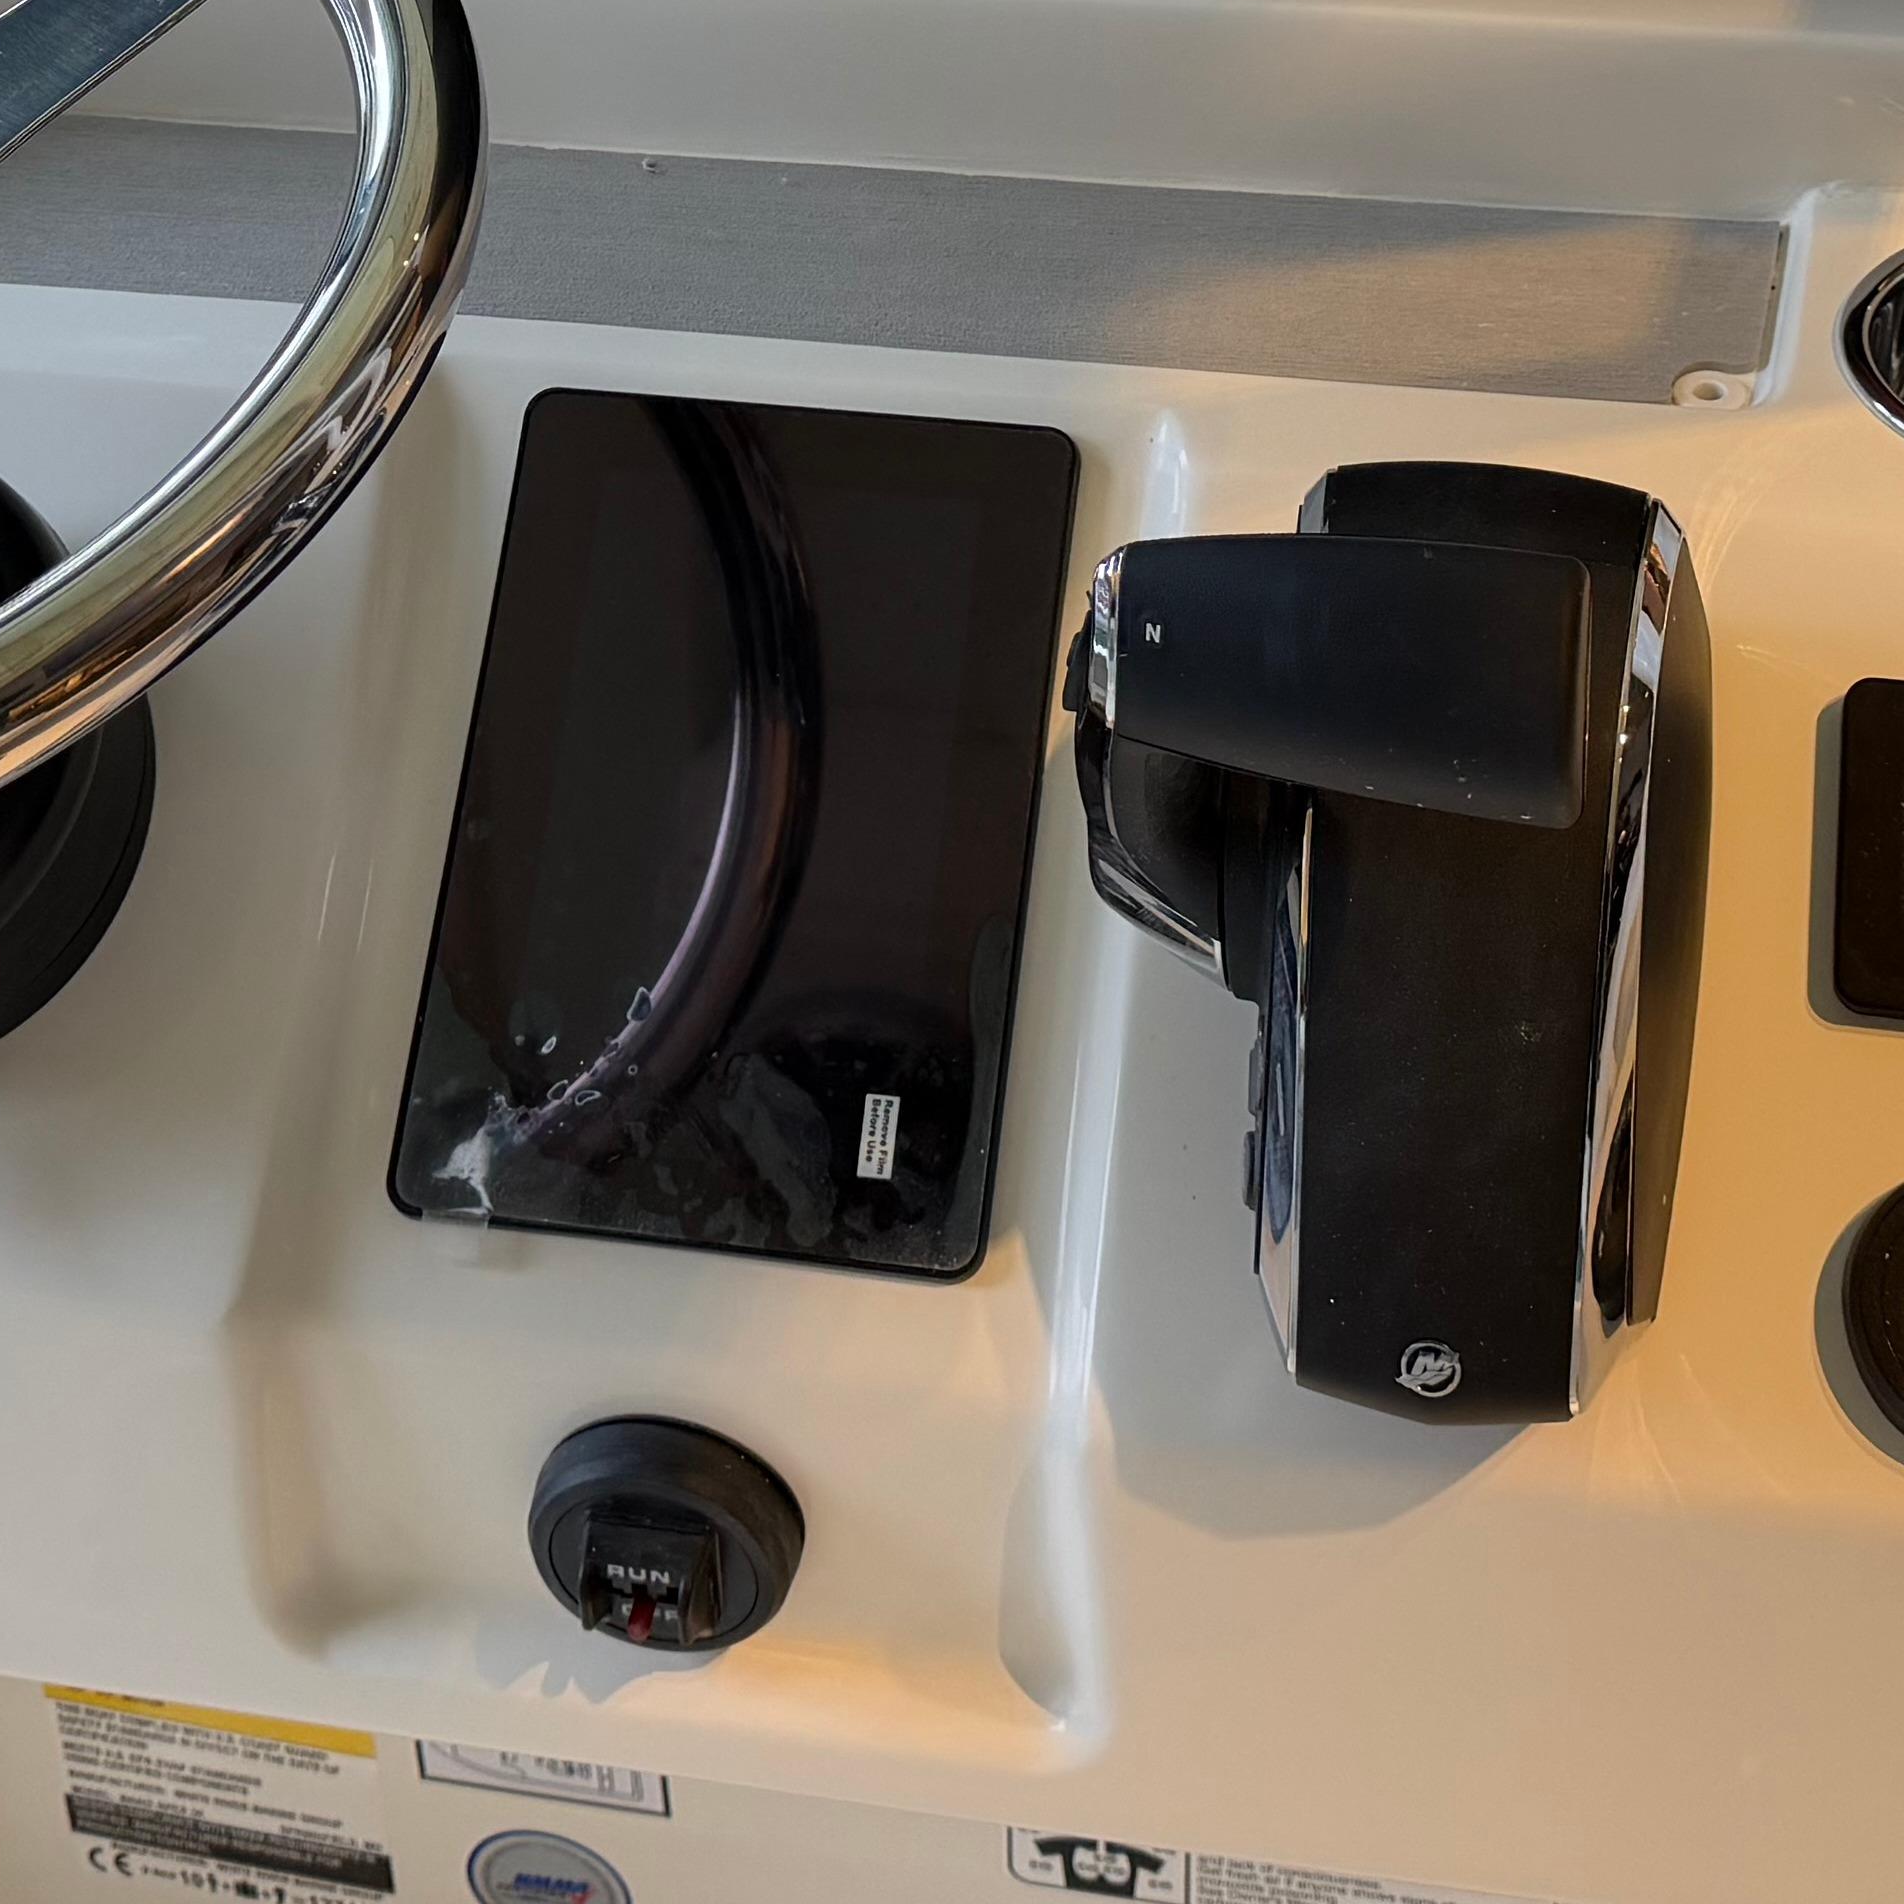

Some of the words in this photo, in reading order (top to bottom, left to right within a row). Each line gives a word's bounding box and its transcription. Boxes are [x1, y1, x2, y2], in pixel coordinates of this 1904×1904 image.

[1145, 622, 1161, 645] N
[869, 1099, 882, 1137] Before
[880, 1100, 894, 1147] Remove
[865, 1140, 876, 1162] Use
[877, 1150, 888, 1175] Film
[606, 1563, 671, 1585] RUN
[621, 1602, 678, 1622] OF
